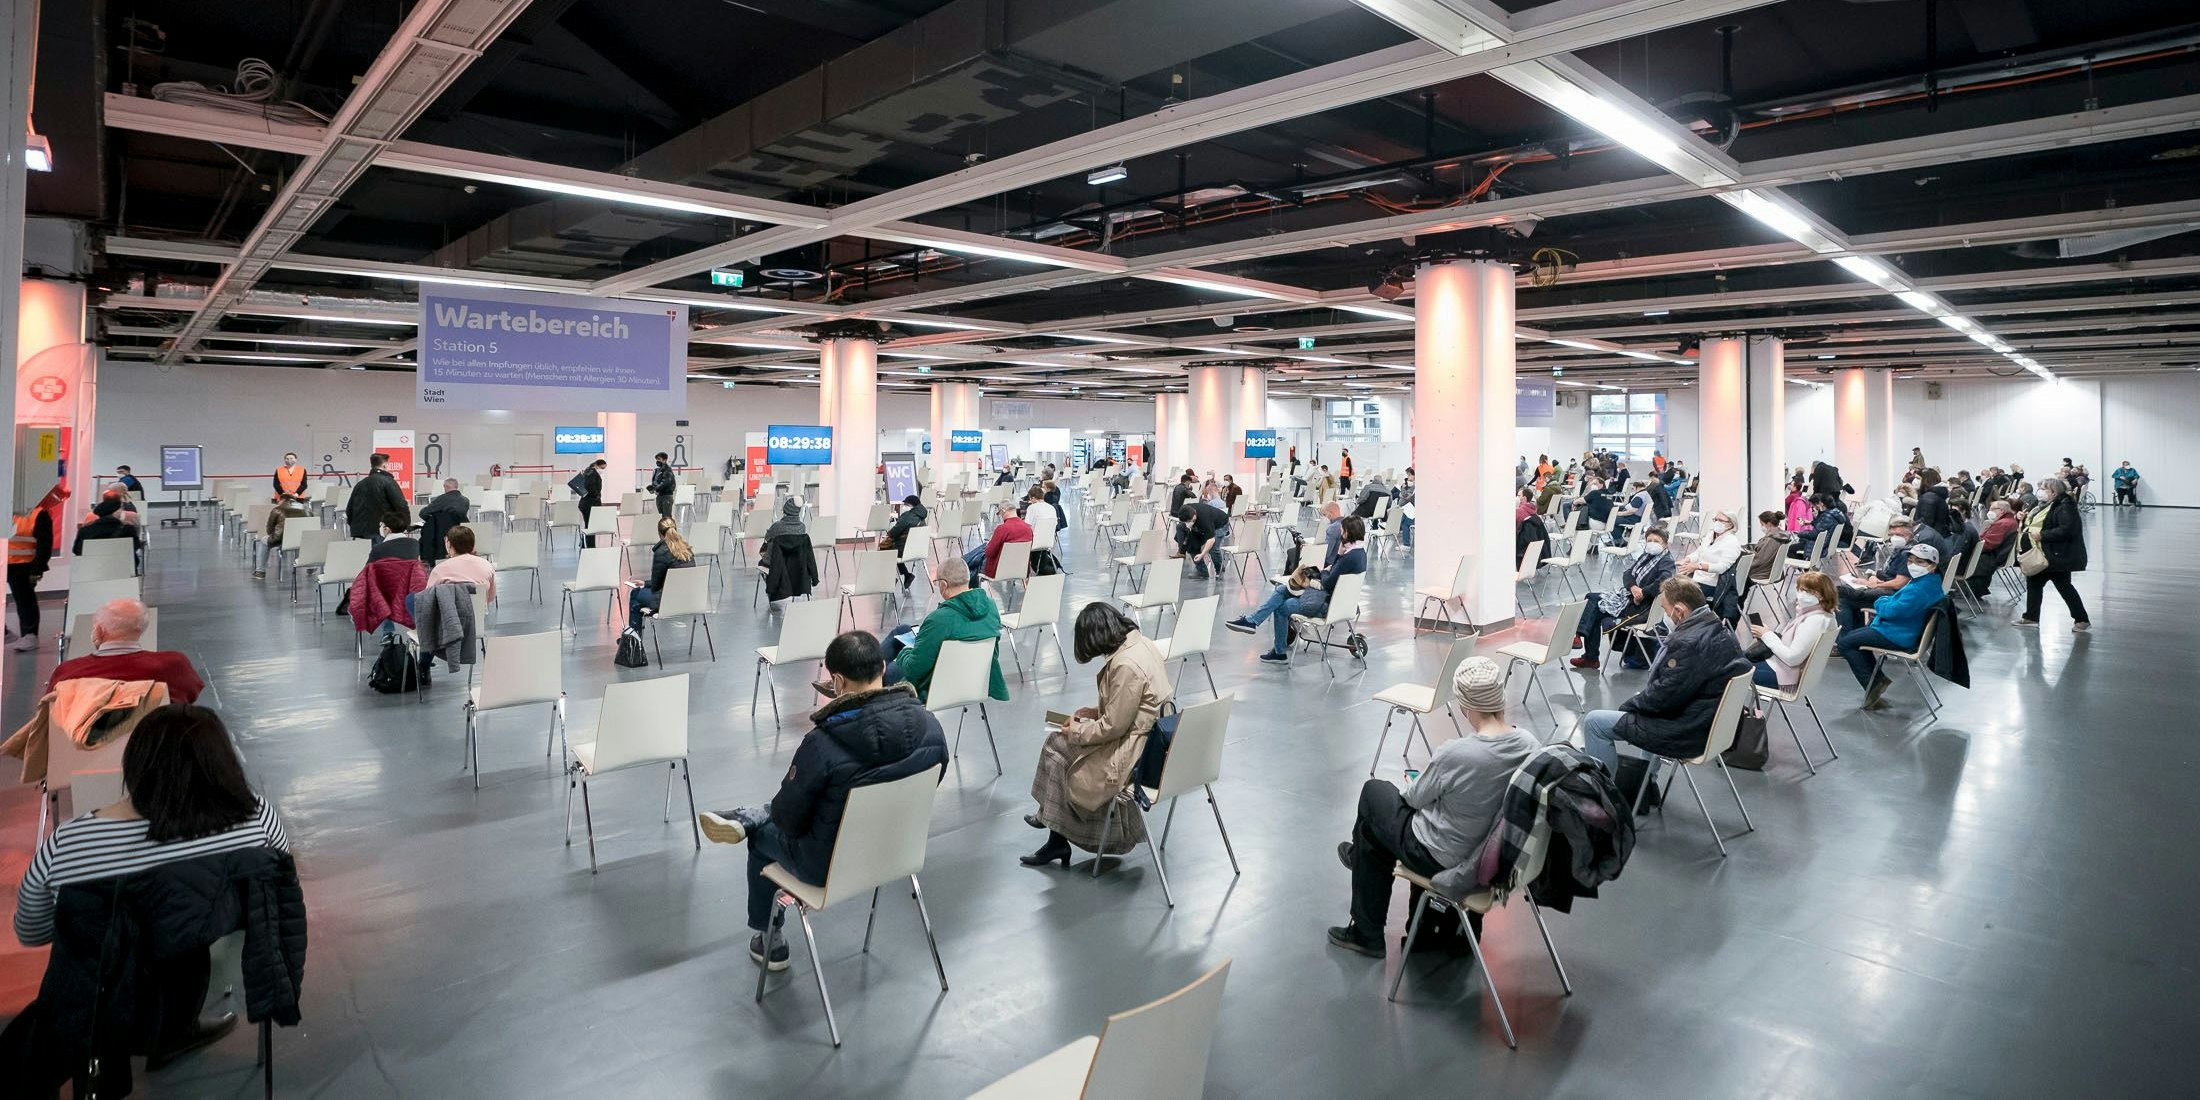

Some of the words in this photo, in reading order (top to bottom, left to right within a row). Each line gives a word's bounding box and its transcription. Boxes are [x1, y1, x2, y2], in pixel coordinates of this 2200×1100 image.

[434, 303, 629, 339] Wartebereich
[432, 338, 486, 353] Station
[488, 342, 498, 354] 5
[432, 357, 450, 366] Wie
[451, 358, 465, 367] bei
[467, 359, 487, 369] allen
[488, 360, 533, 373] Impfungen
[560, 364, 602, 375] empfehlen
[433, 367, 444, 377] 15
[445, 368, 482, 378] Minuten
[494, 370, 524, 380] warten
[525, 371, 569, 382] (Menschen
[569, 374, 582, 382] mit
[583, 374, 616, 385] Allergien
[423, 388, 446, 396] Stadt
[768, 436, 831, 450] 08:29:38
[1246, 437, 1275, 447] 08:29:38
[887, 466, 911, 478] WC
